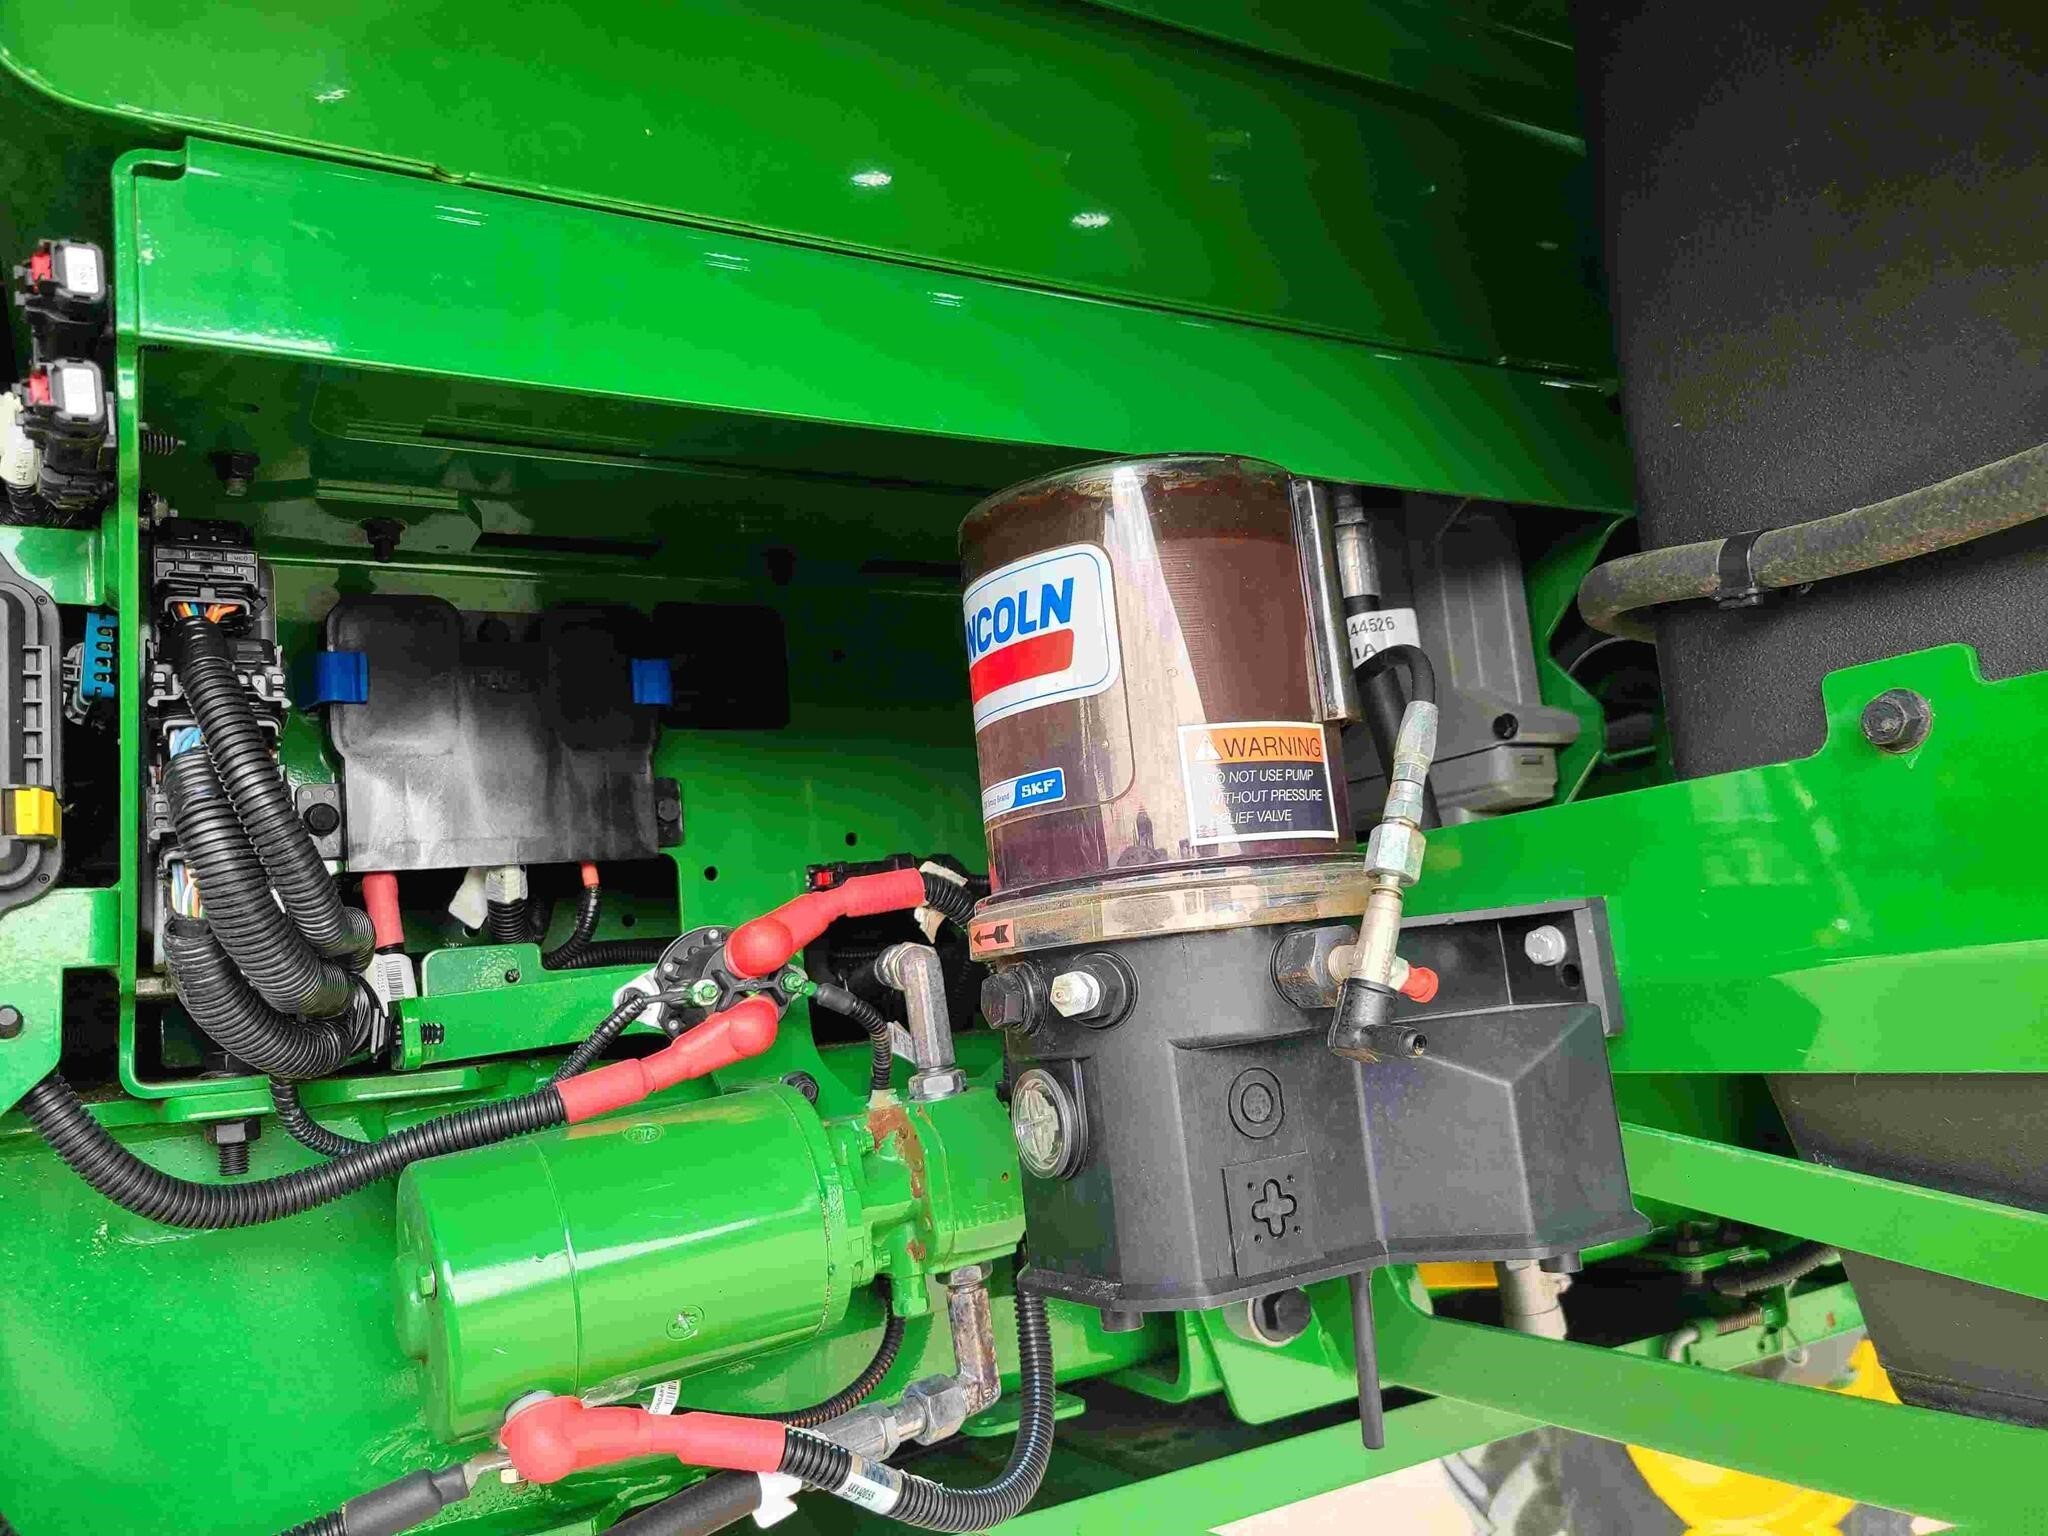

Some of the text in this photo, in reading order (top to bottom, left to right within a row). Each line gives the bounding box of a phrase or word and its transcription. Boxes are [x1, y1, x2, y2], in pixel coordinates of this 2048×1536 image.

[965, 577, 1074, 662] NCOLN
[1223, 735, 1321, 758] WARNING
[1228, 769, 1258, 784] NOT
[1259, 768, 1284, 782] USE
[1285, 768, 1314, 782] PUMP
[1021, 778, 1056, 799] SKF
[1270, 788, 1323, 802] PRESSURE
[1256, 809, 1292, 823] VALVE
